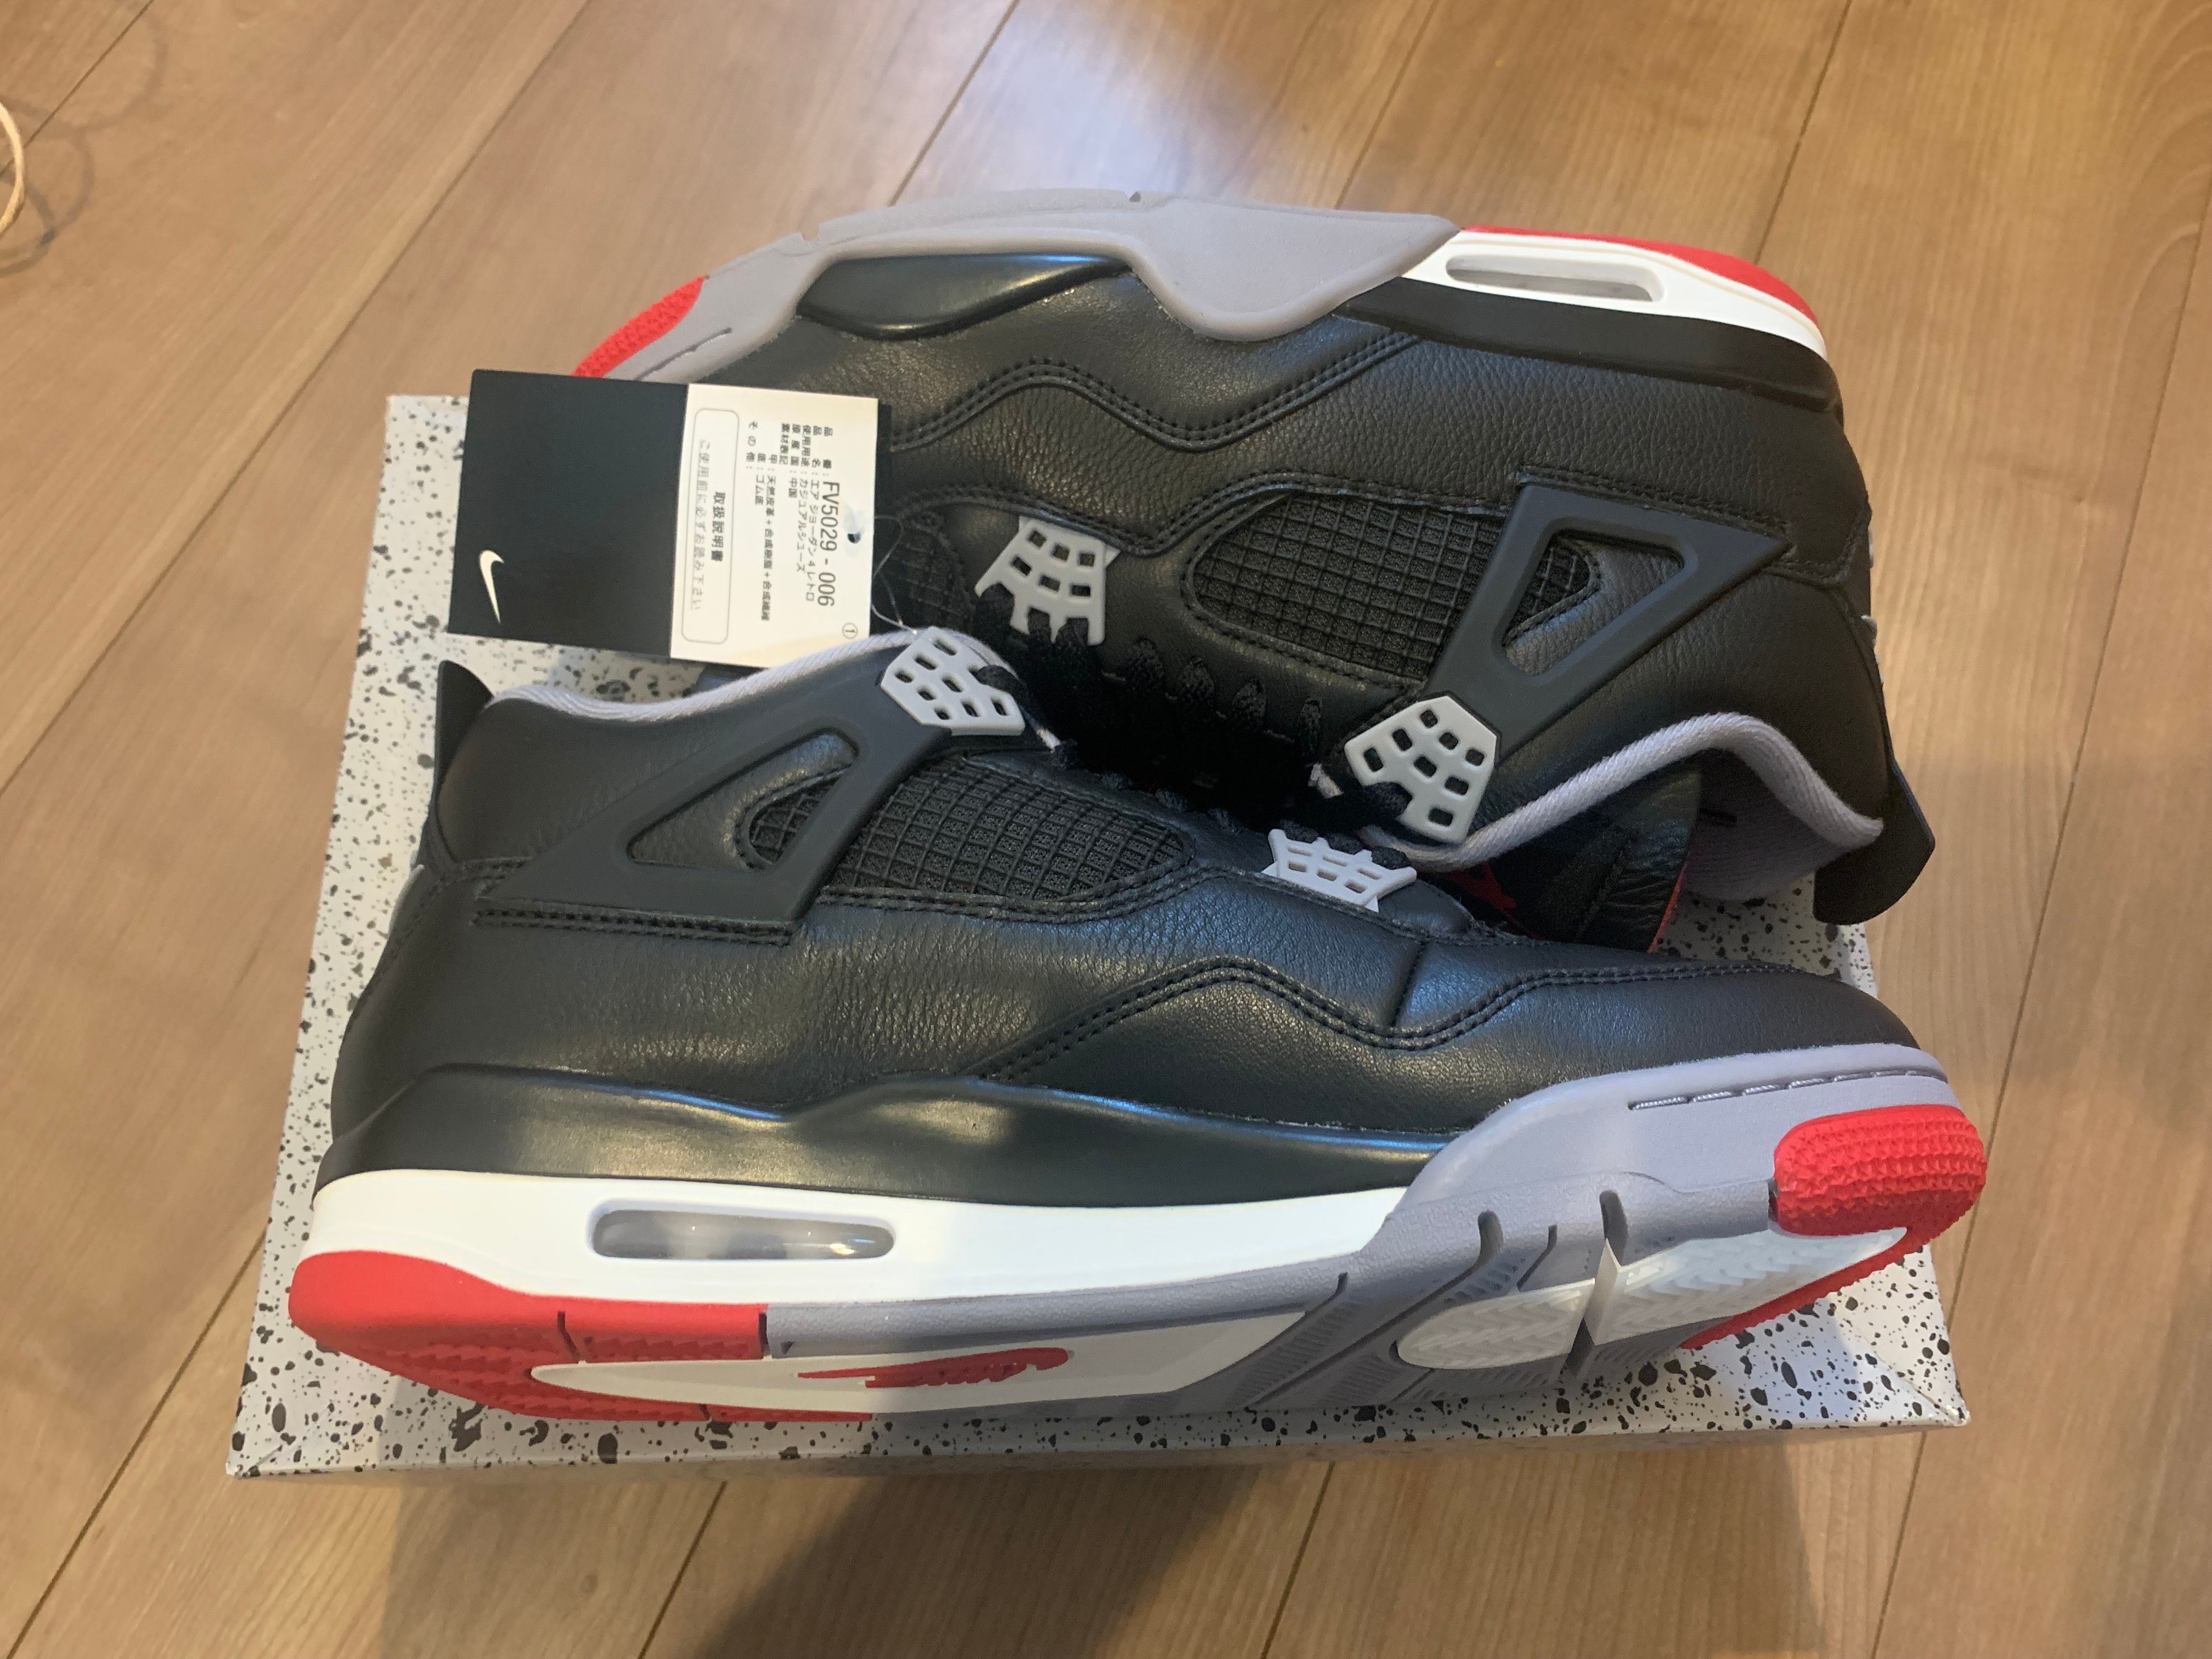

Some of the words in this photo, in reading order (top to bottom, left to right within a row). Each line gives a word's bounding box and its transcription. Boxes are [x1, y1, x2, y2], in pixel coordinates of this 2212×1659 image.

[711, 492, 725, 561] 取扱説明書
